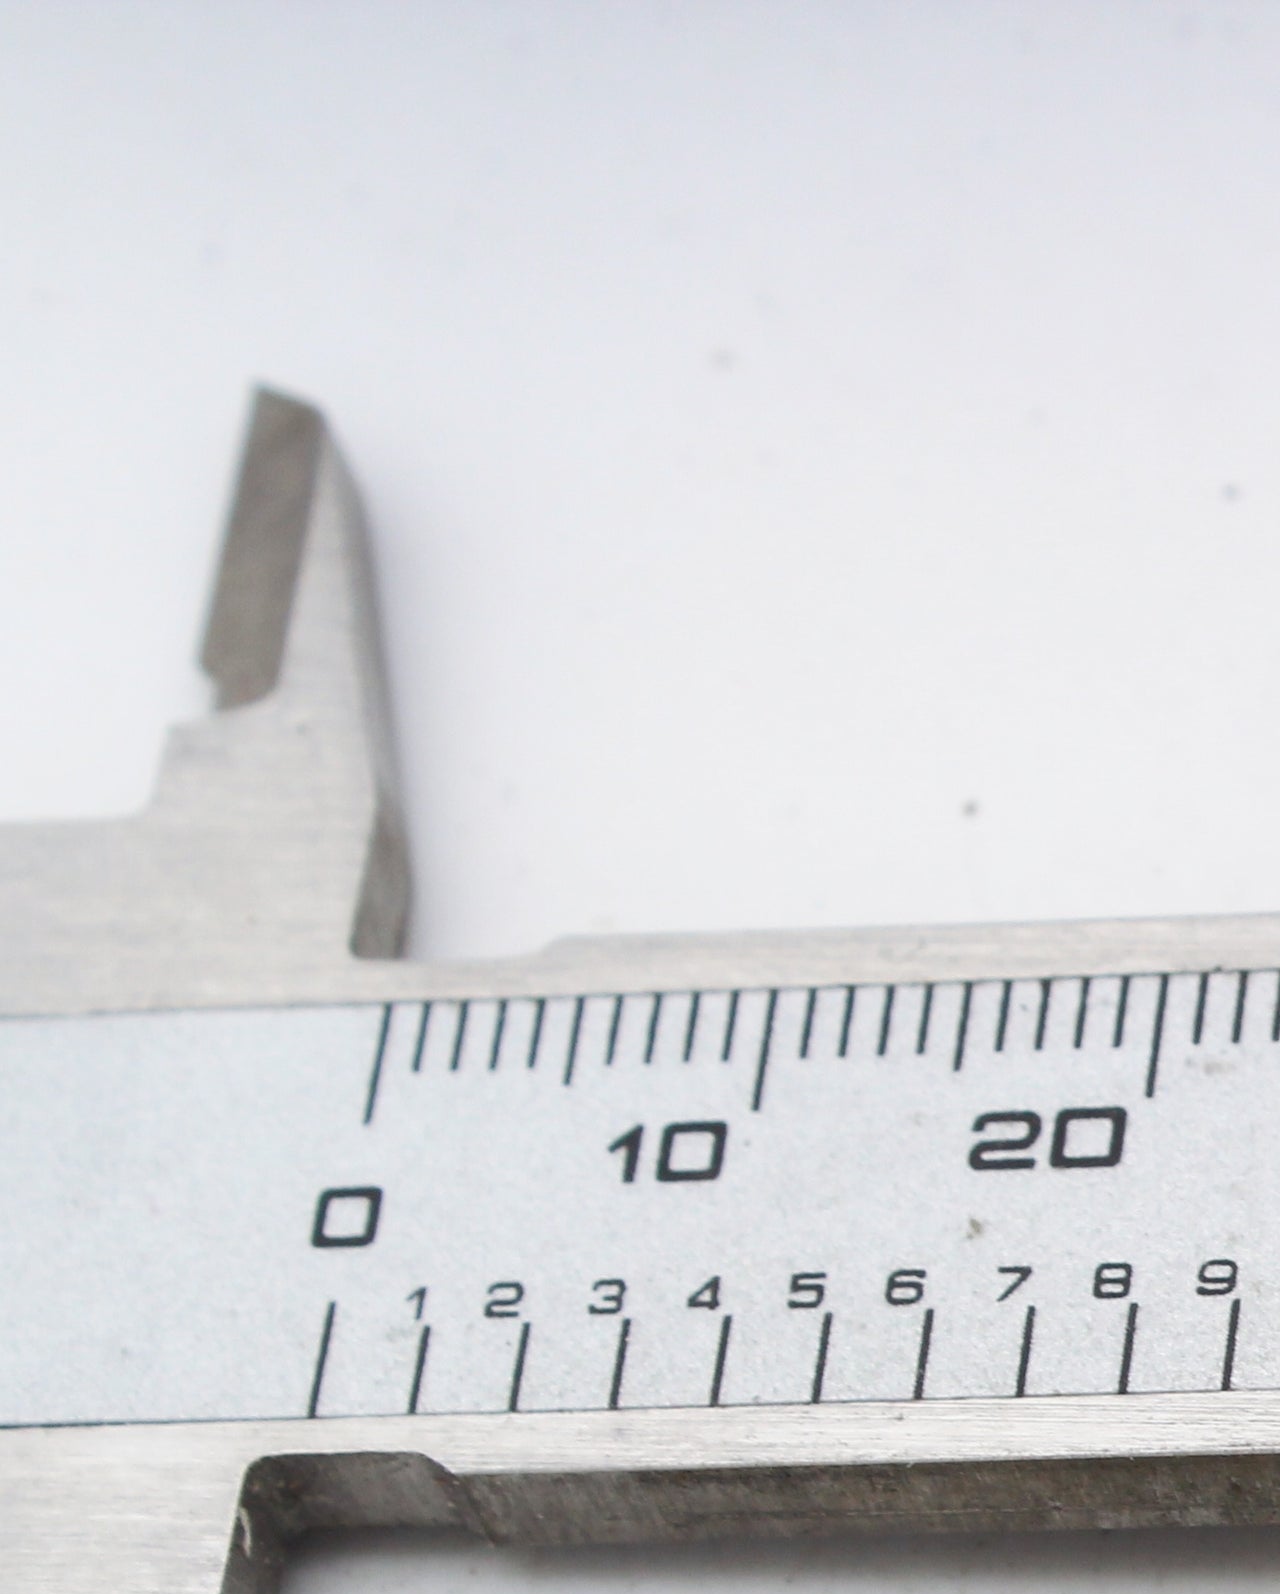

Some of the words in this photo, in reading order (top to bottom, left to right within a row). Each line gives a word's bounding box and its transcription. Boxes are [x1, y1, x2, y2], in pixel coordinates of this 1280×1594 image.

[608, 1120, 728, 1184] 10
[967, 1105, 1128, 1172] 20
[310, 1185, 384, 1249] 0
[407, 1286, 428, 1321] 1
[483, 1281, 525, 1319] 2
[587, 1278, 628, 1316] 3
[686, 1275, 721, 1311] 4
[787, 1271, 827, 1310] 5
[884, 1268, 927, 1307] 6
[996, 1265, 1033, 1303] 7
[1092, 1262, 1134, 1300] 8
[1195, 1258, 1239, 1297] 9
